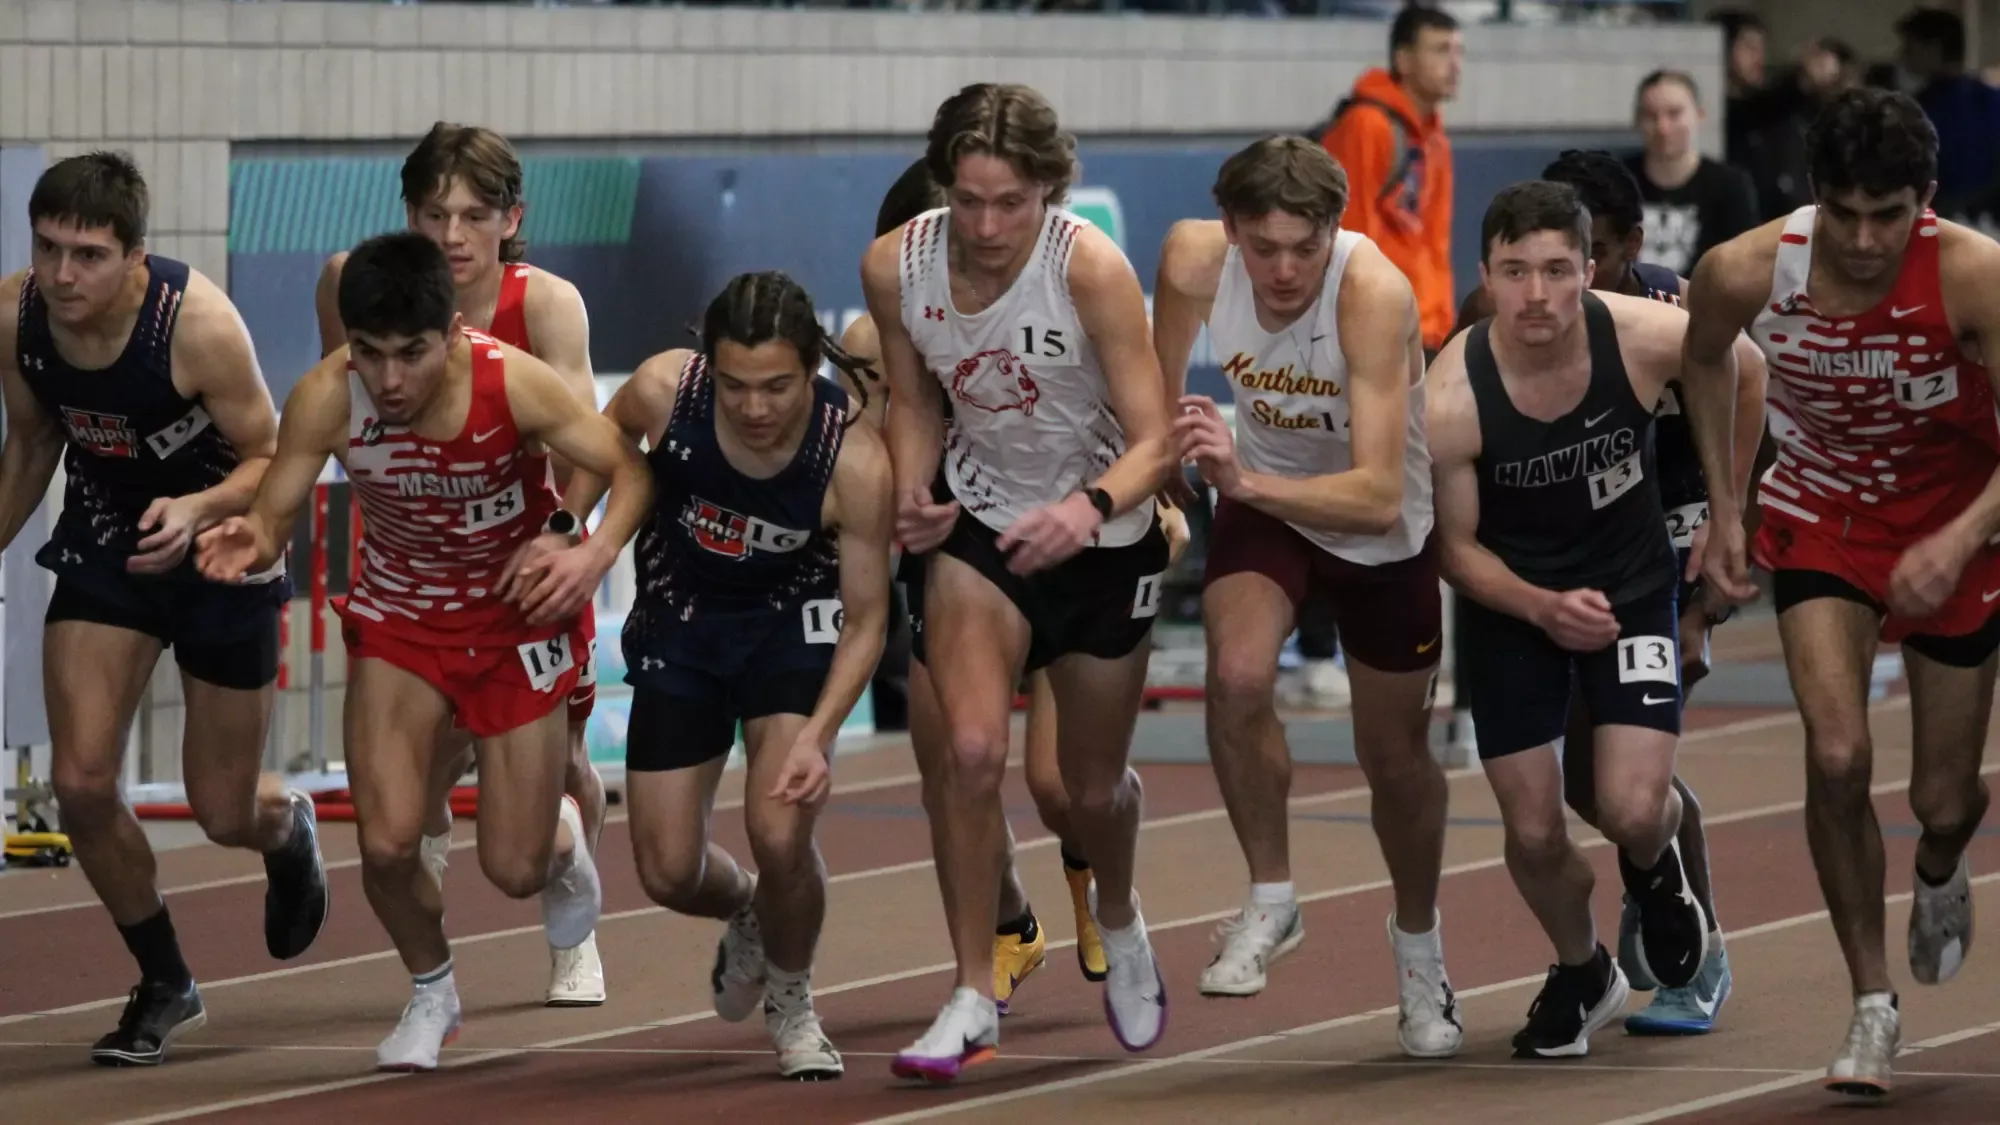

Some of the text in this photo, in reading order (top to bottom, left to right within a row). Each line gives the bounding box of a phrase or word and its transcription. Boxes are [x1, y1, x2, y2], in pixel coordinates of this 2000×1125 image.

[1020, 326, 1066, 357] 15
[1223, 352, 1341, 397] Northern
[1807, 350, 1894, 379] MSUM
[1901, 375, 1945, 402] 12
[1250, 399, 1320, 430] State
[154, 415, 196, 451] 19
[1495, 427, 1634, 487] HAWKS
[397, 472, 487, 499] MSUM
[1593, 461, 1632, 499] 13
[471, 491, 515, 522] 18
[751, 523, 797, 547] 16
[525, 635, 563, 677] 18
[1623, 642, 1668, 670] 13
